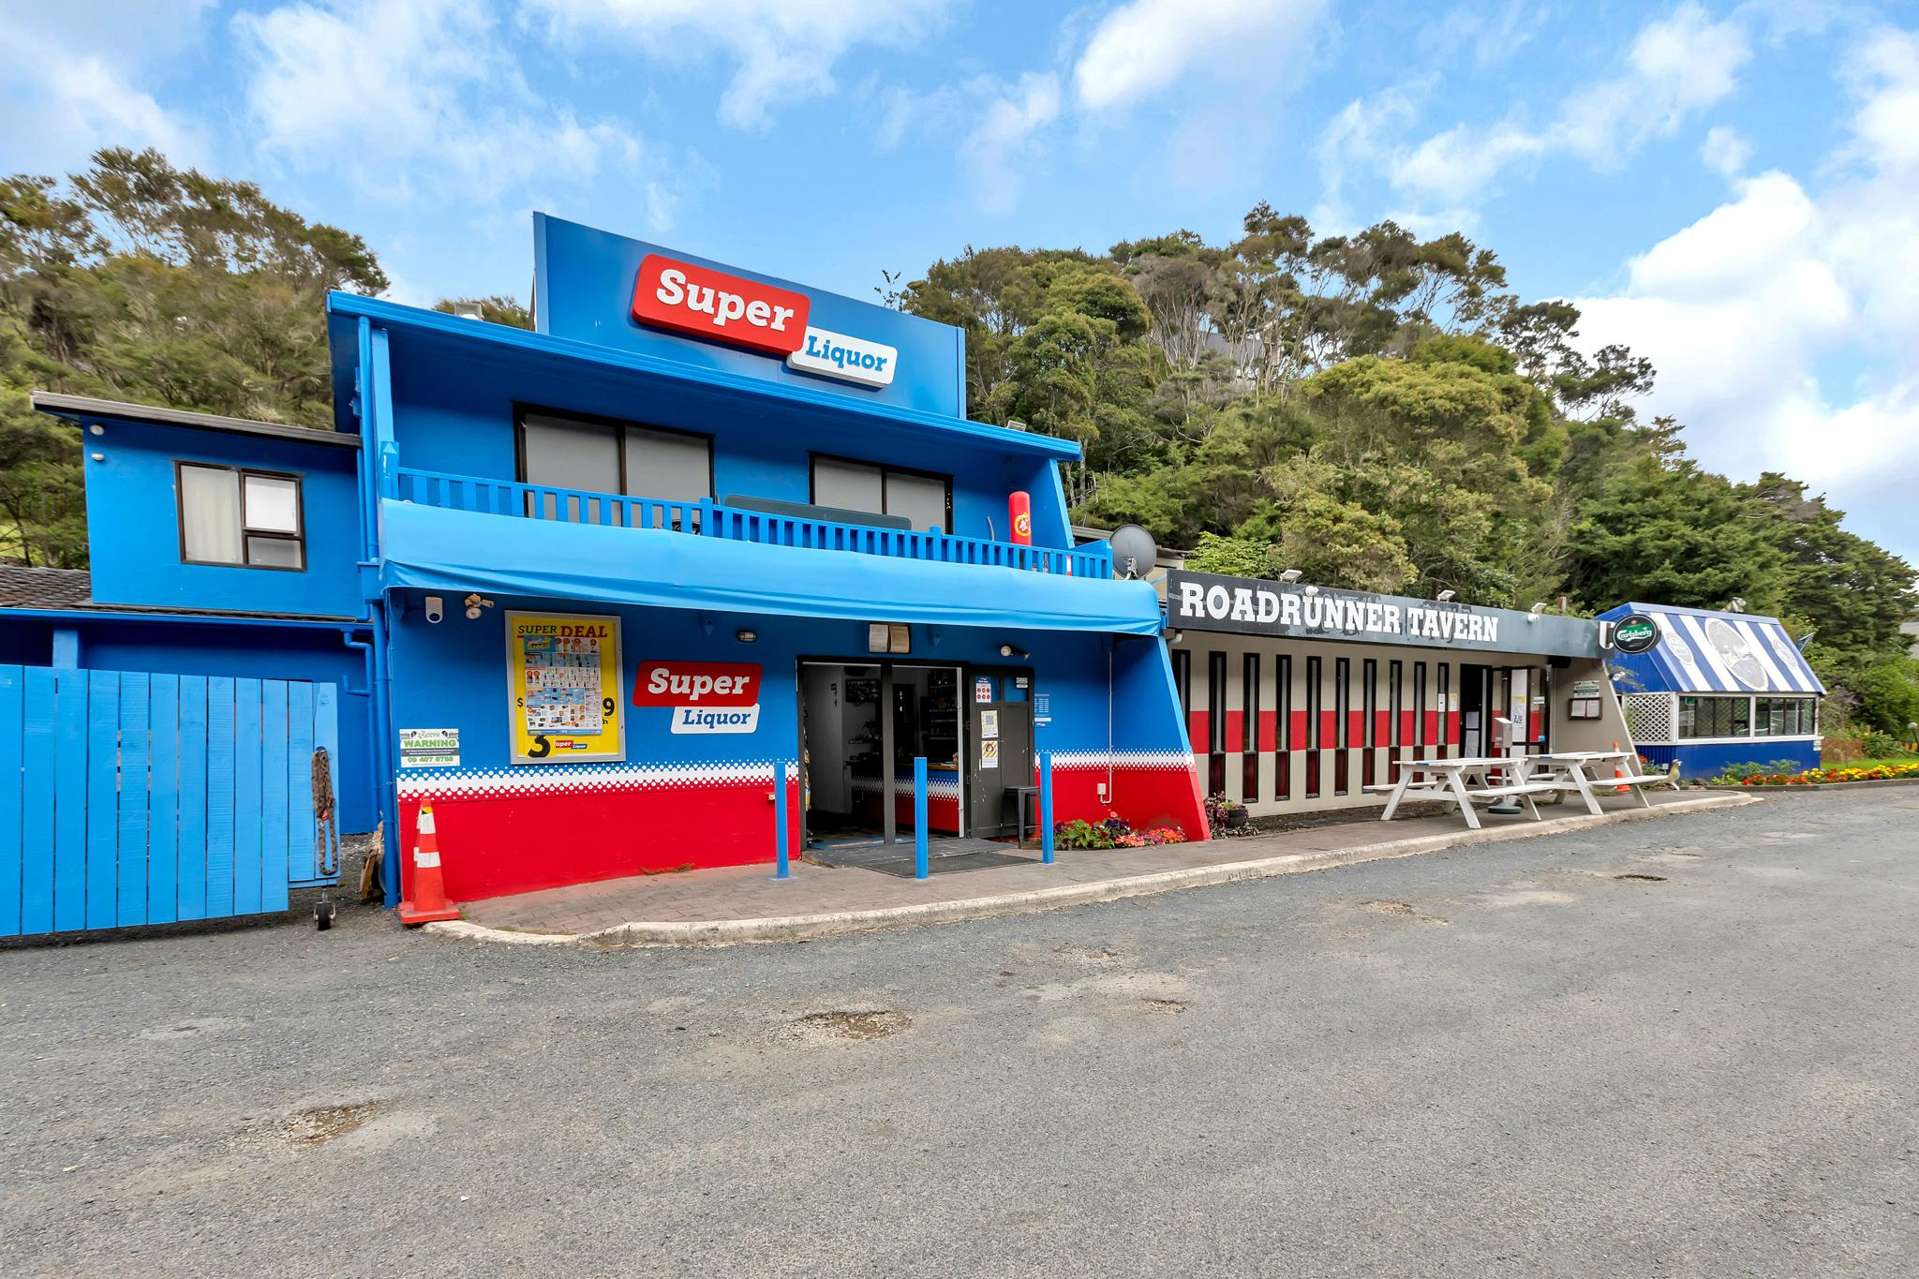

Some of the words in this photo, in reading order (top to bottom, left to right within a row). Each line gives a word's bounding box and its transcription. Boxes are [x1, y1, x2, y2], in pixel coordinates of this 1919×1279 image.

[656, 269, 794, 332] Super
[806, 335, 887, 372] Liquor
[1179, 581, 1401, 634] ROADRUNNER
[1406, 606, 1499, 642] TAVERN
[518, 624, 558, 635] SUPER
[560, 624, 608, 638] DEAL
[1616, 627, 1653, 642] Carlsberg
[647, 667, 751, 701] Super
[682, 708, 751, 729] Liquor
[403, 739, 457, 748] WARNING
